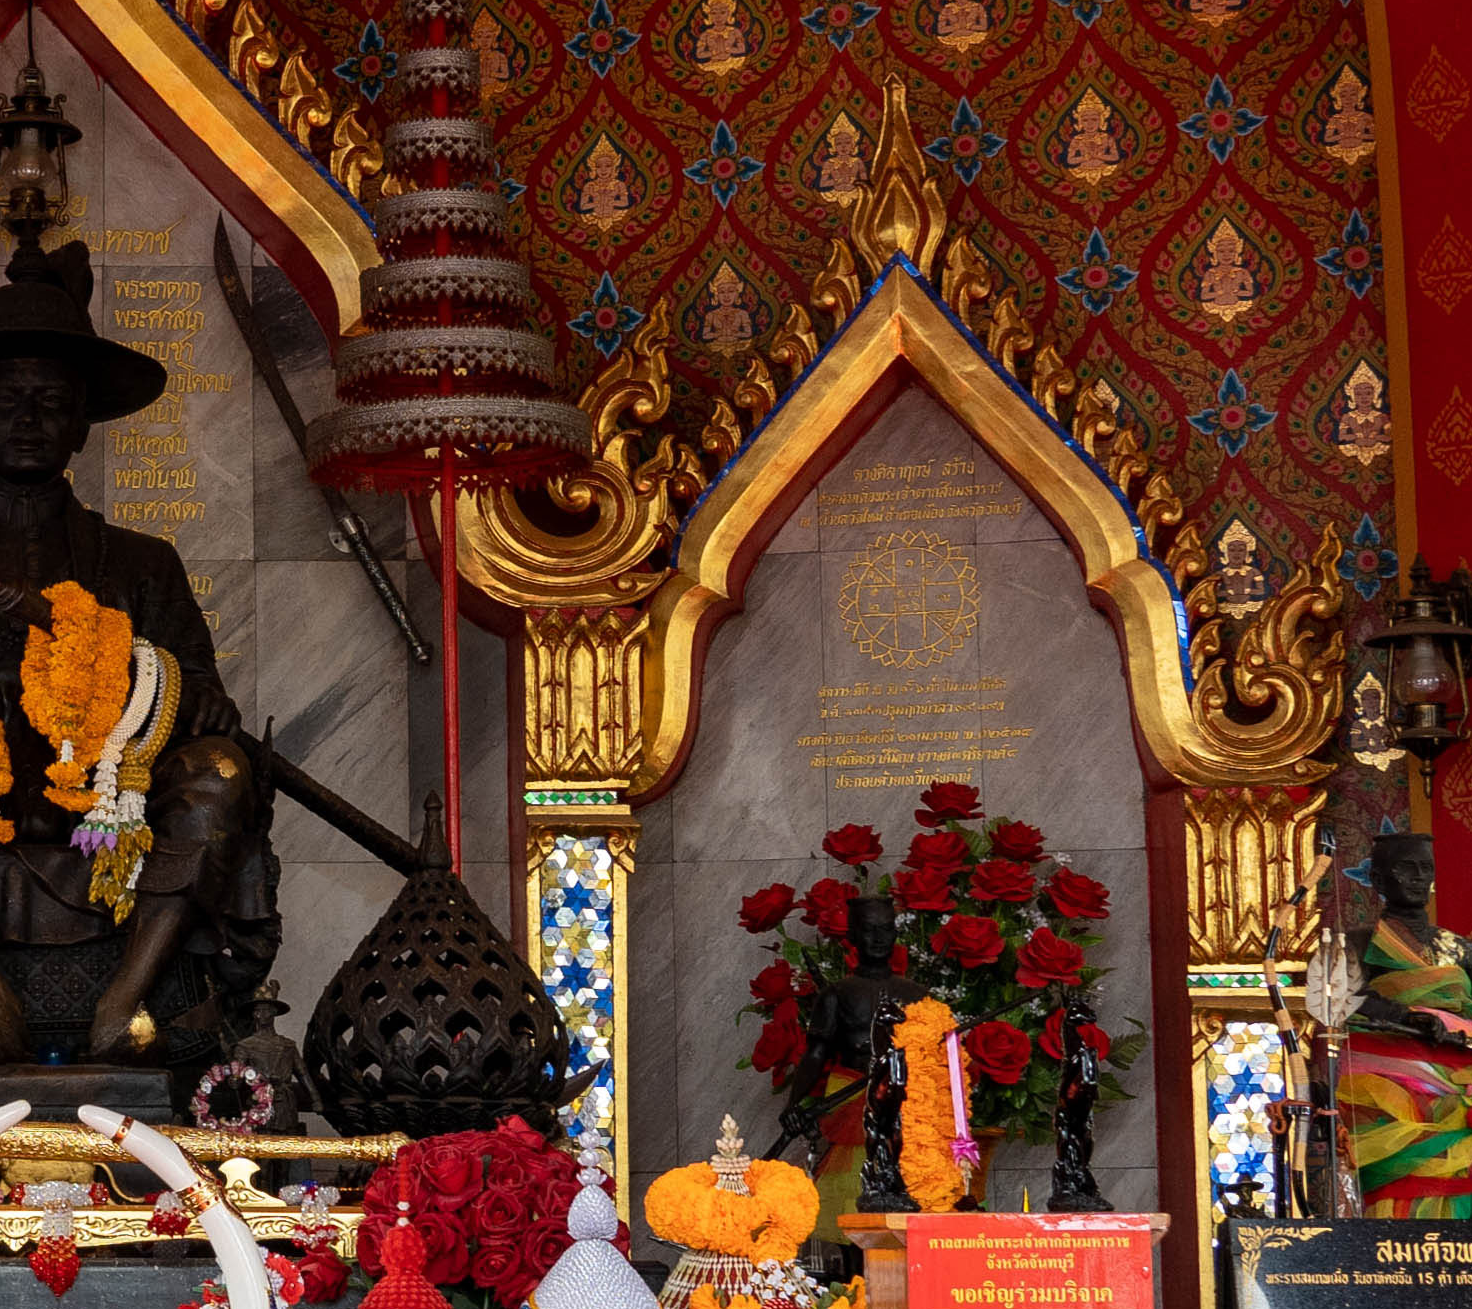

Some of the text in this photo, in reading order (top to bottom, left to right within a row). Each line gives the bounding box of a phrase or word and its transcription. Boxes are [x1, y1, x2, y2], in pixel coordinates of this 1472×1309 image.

[928, 1232, 1130, 1249] ศาลสมเด็จพระเจ้าตากสินมหาราช
[986, 1253, 1075, 1274] จังหวัดจันทบุรี
[1418, 1272, 1434, 1284] 15
[950, 1279, 1113, 1308] ขอเชิญร่วมบริจาค
